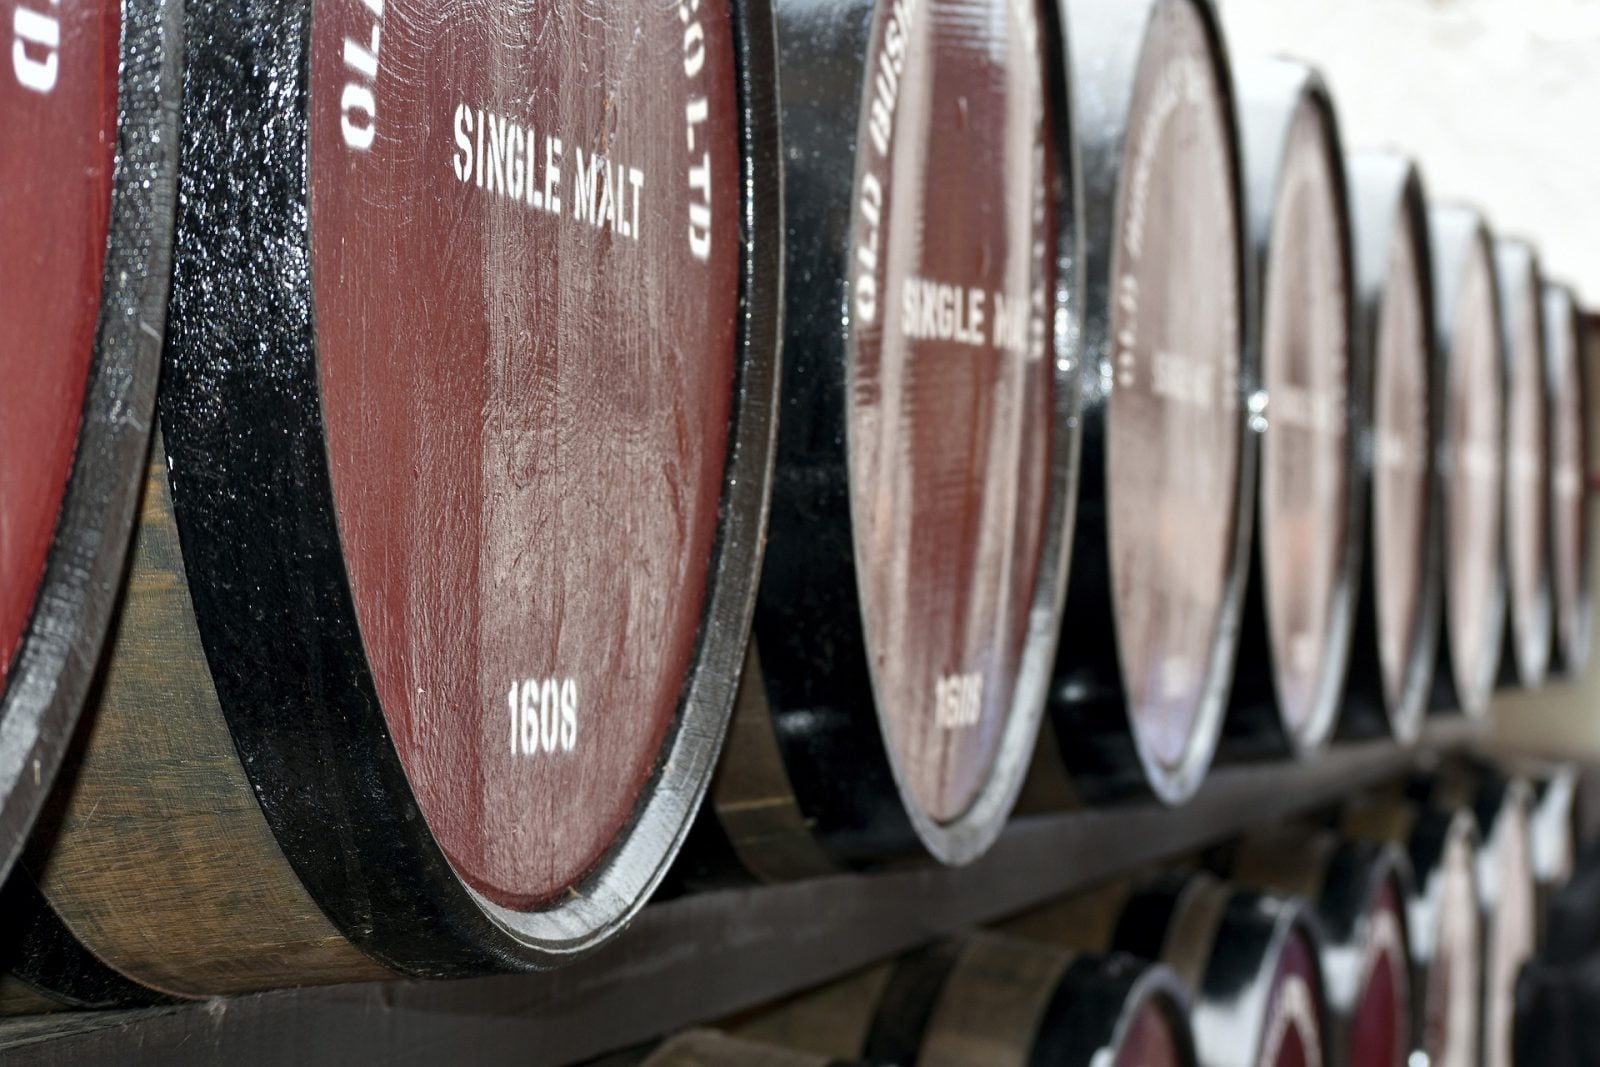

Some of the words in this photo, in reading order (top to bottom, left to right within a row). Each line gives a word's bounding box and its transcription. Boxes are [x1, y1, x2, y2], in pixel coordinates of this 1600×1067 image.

[341, 0, 384, 150] OL
[453, 103, 562, 214] SINGLE
[574, 146, 645, 240] MALT
[686, 98, 711, 262] LTD
[857, 172, 883, 322] OLD
[870, 0, 916, 157] BUSH
[902, 277, 986, 346] SINGLE
[508, 677, 577, 756] 1608
